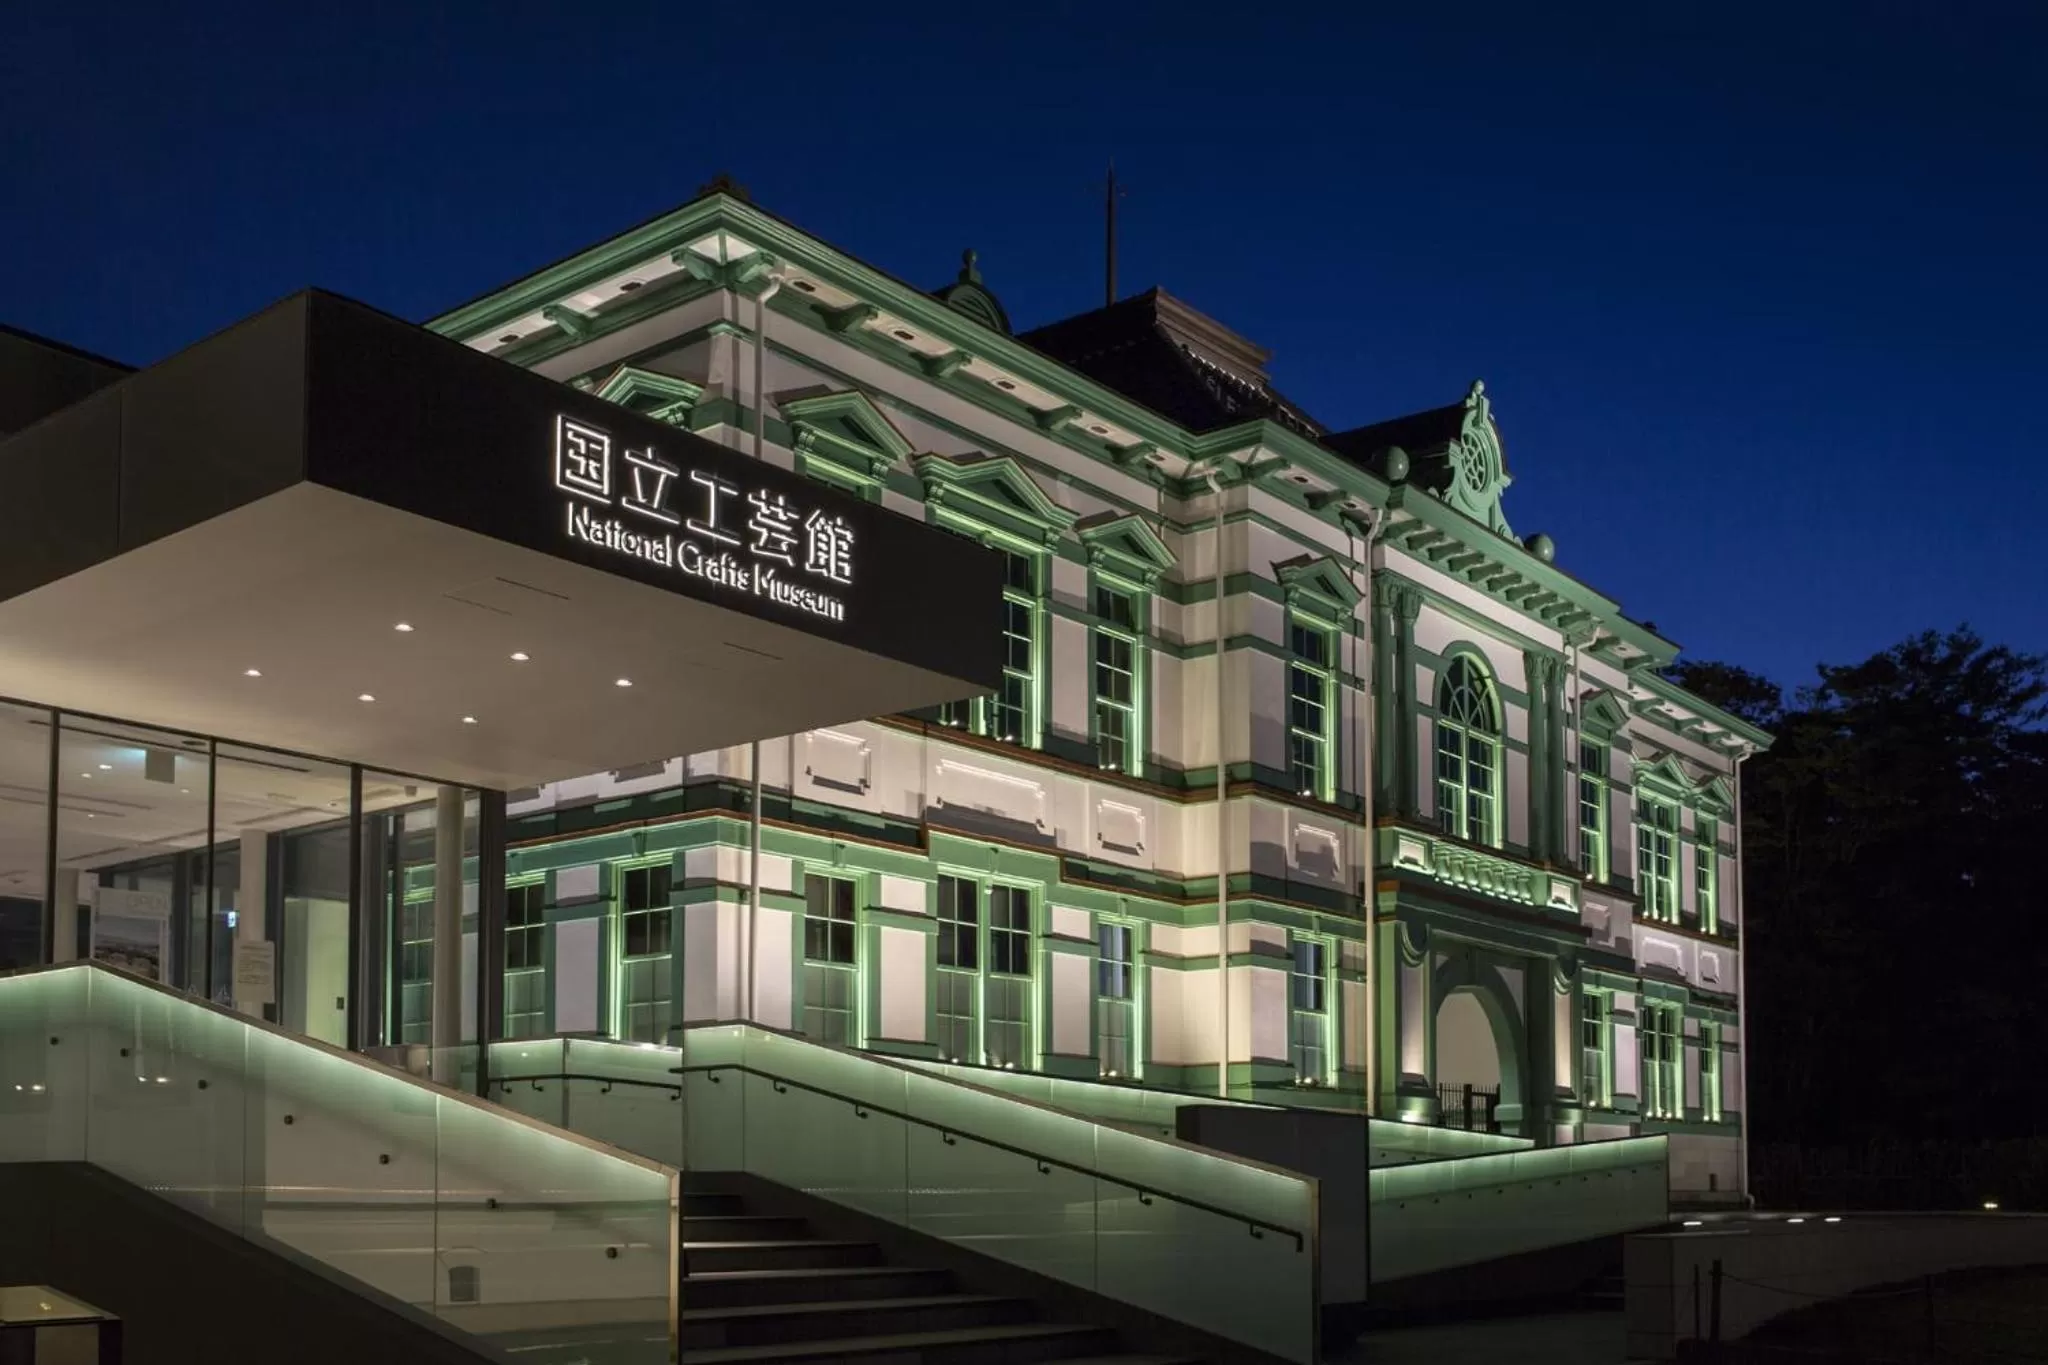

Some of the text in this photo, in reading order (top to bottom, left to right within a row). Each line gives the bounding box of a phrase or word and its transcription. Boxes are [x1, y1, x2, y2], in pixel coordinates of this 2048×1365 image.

[556, 413, 854, 584] 国立工芸館
[568, 501, 845, 621] National Crafts Museum
